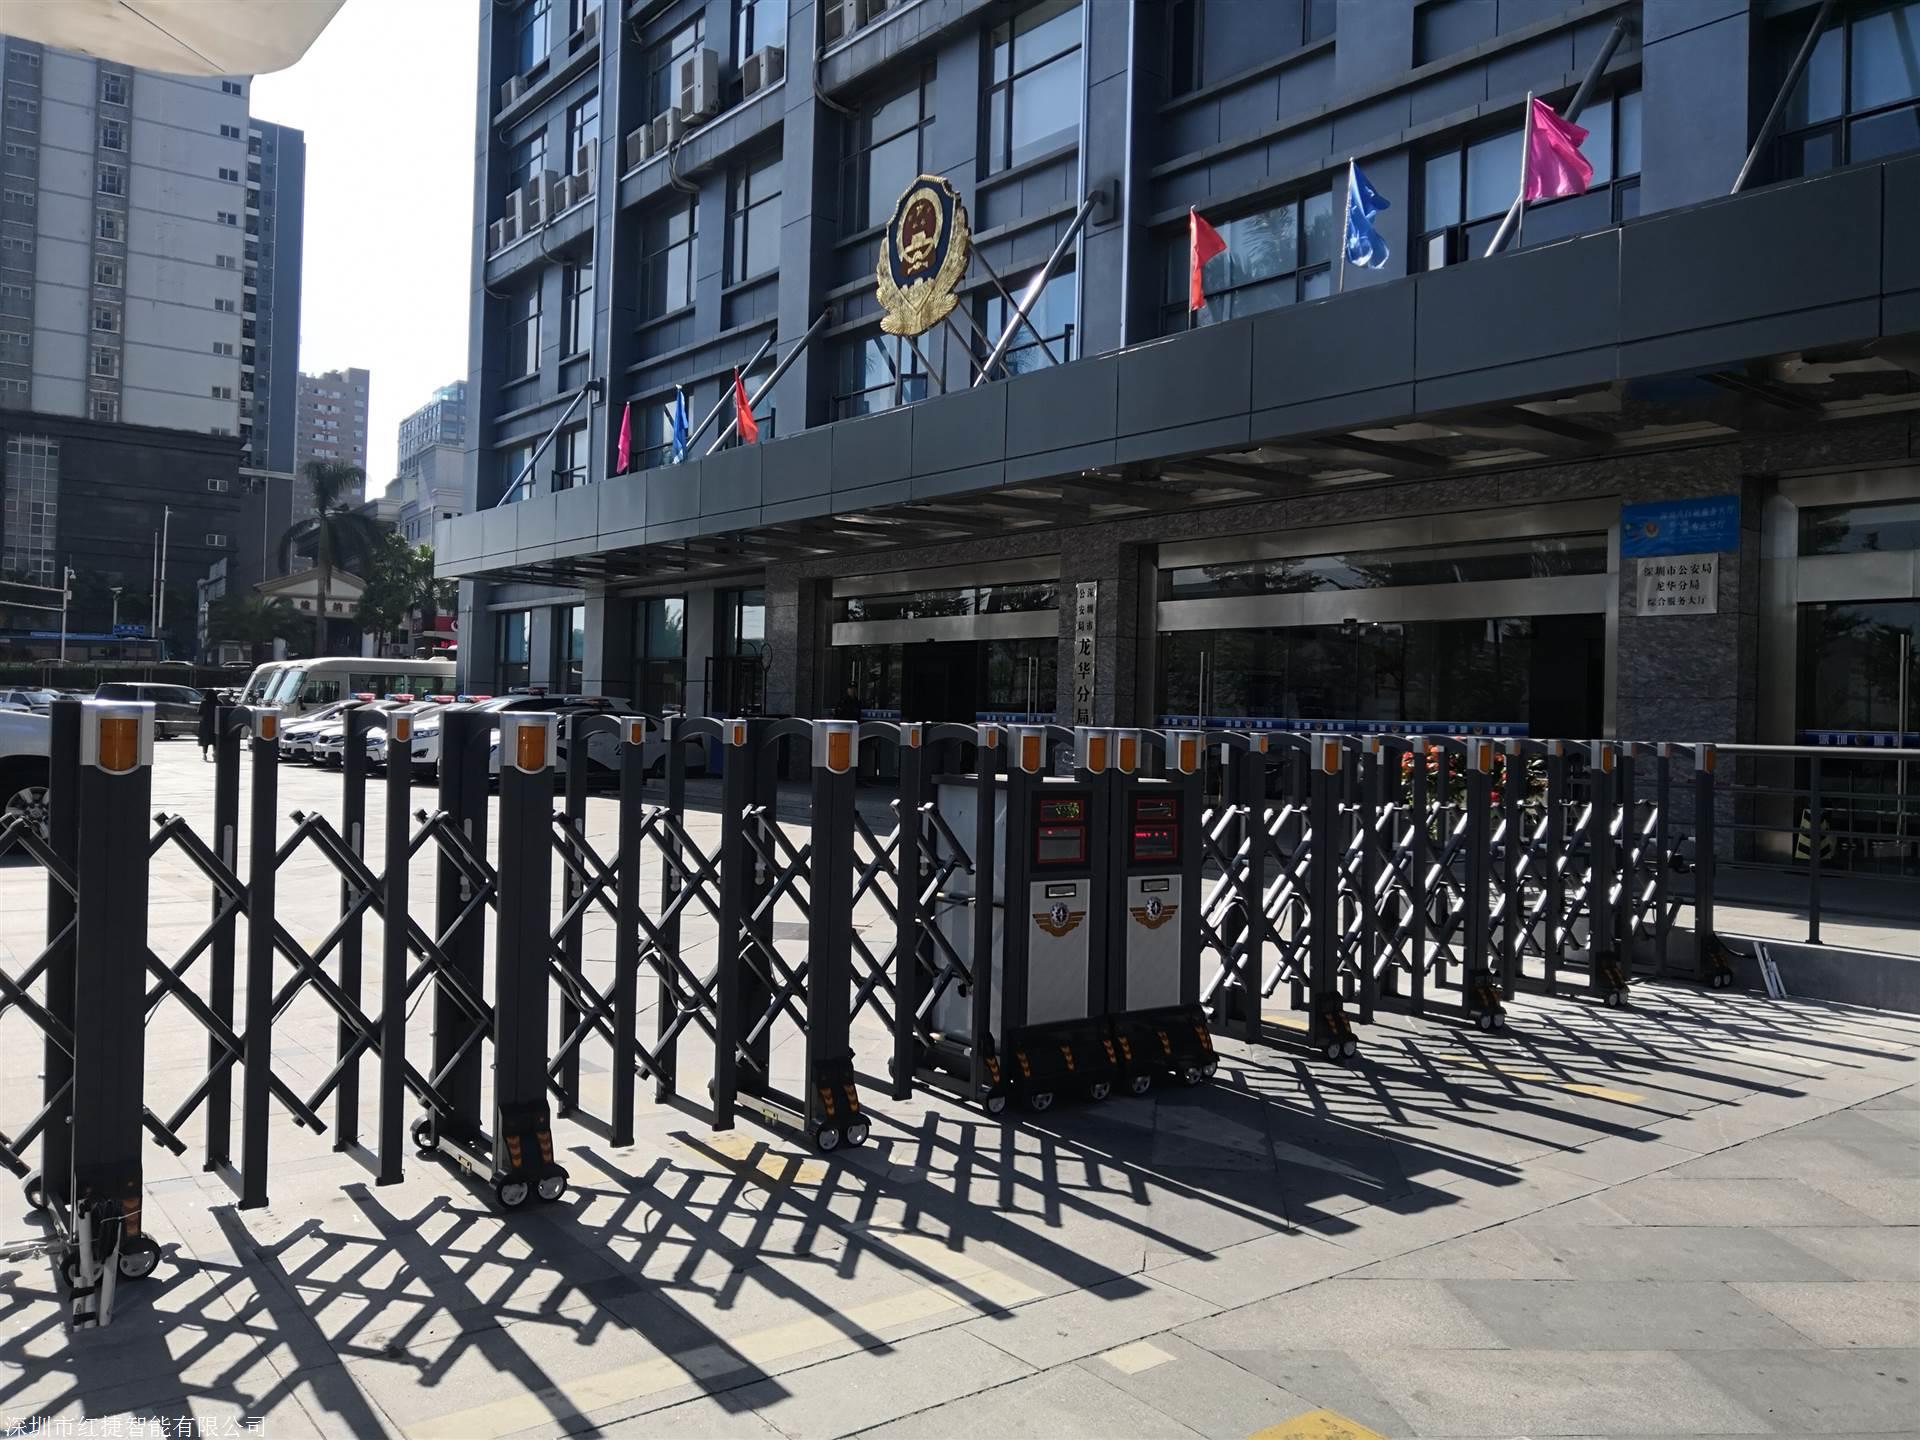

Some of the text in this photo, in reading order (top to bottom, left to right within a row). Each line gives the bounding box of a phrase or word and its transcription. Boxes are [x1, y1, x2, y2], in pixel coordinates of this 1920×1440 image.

[1643, 563, 1712, 576] 深圳市公安局
[1656, 579, 1700, 591] 龙华分局
[1077, 638, 1091, 725] 龙华分局
